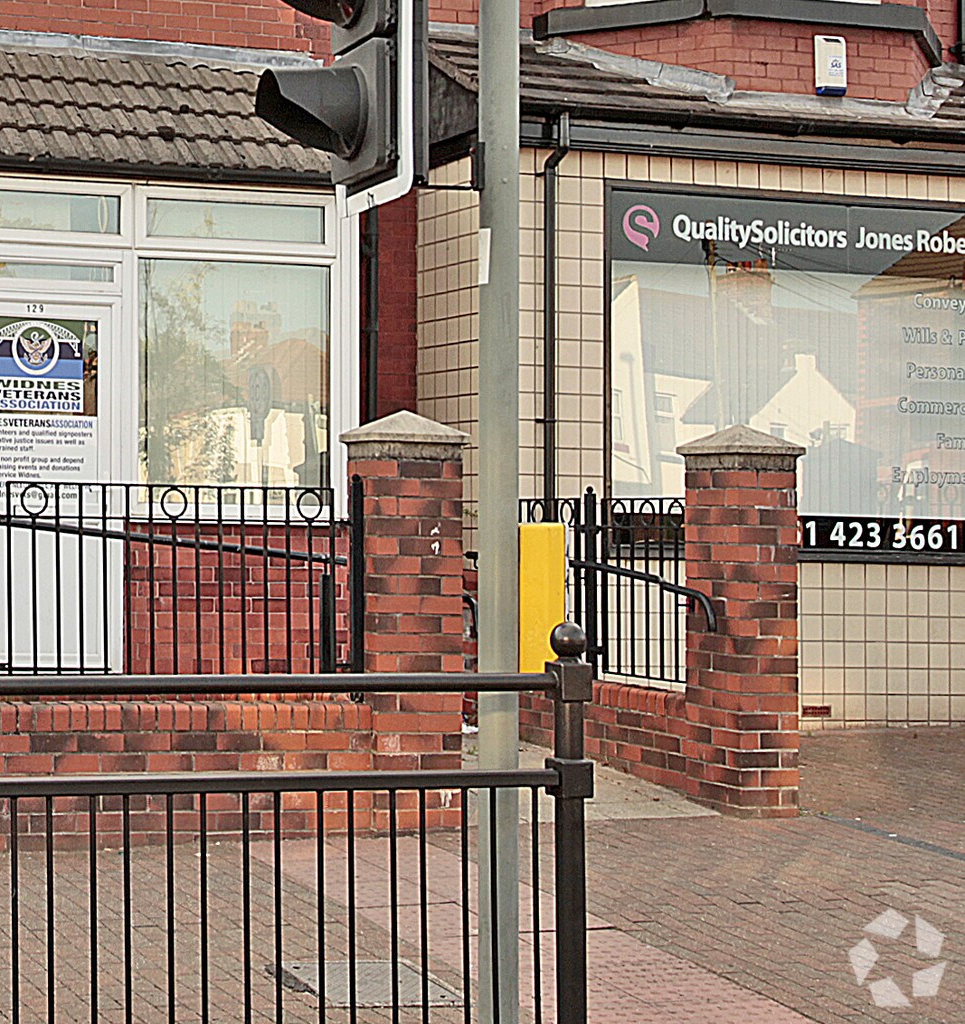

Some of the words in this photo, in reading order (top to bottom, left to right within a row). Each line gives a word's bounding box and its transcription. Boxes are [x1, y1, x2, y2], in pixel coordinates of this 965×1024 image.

[672, 213, 847, 249] QualitySolicitors
[855, 226, 913, 252] Jones
[26, 303, 44, 313] 129
[902, 326, 937, 345] Wills
[940, 328, 953, 345] &
[829, 521, 881, 548] 423
[892, 523, 958, 550] 3661
